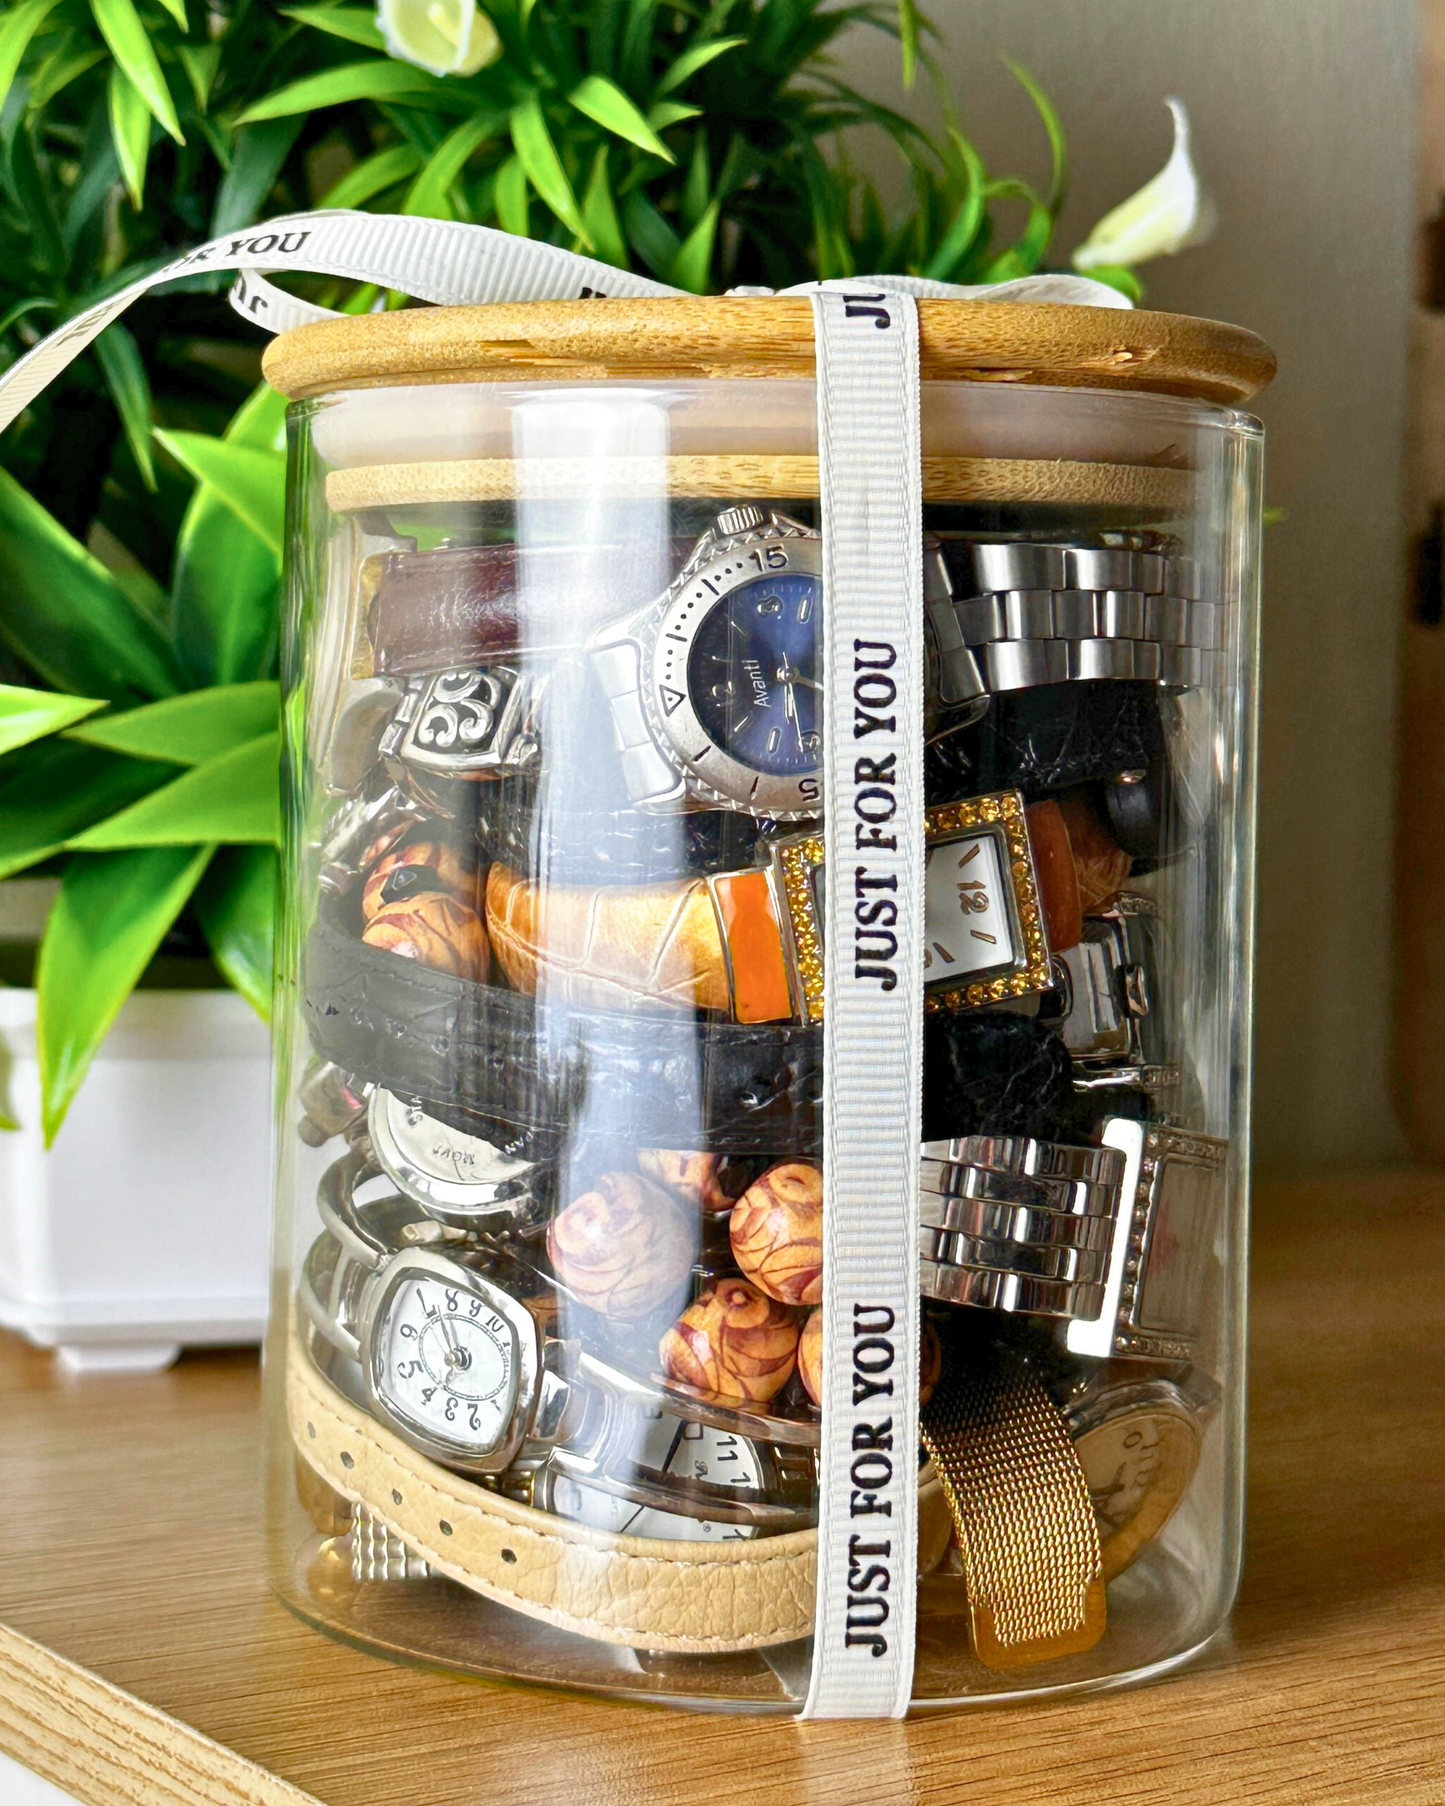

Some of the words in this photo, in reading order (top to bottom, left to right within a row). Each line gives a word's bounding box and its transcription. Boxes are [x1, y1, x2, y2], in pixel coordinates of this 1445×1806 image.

[225, 231, 312, 257] YOU
[749, 546, 789, 573] 15
[741, 658, 773, 709] Avanti
[853, 638, 898, 740] YOU
[853, 752, 898, 852] FOR
[957, 880, 989, 915] 12
[854, 866, 899, 991] JUST
[445, 1288, 460, 1312] 8
[400, 1323, 418, 1341] 6
[397, 1360, 424, 1379] 5
[852, 1303, 895, 1406] YOU
[421, 1386, 438, 1406] 4
[445, 1397, 459, 1421] 3
[467, 1403, 482, 1431] 2
[850, 1416, 894, 1519] FOR
[845, 1534, 891, 1658] JUST
